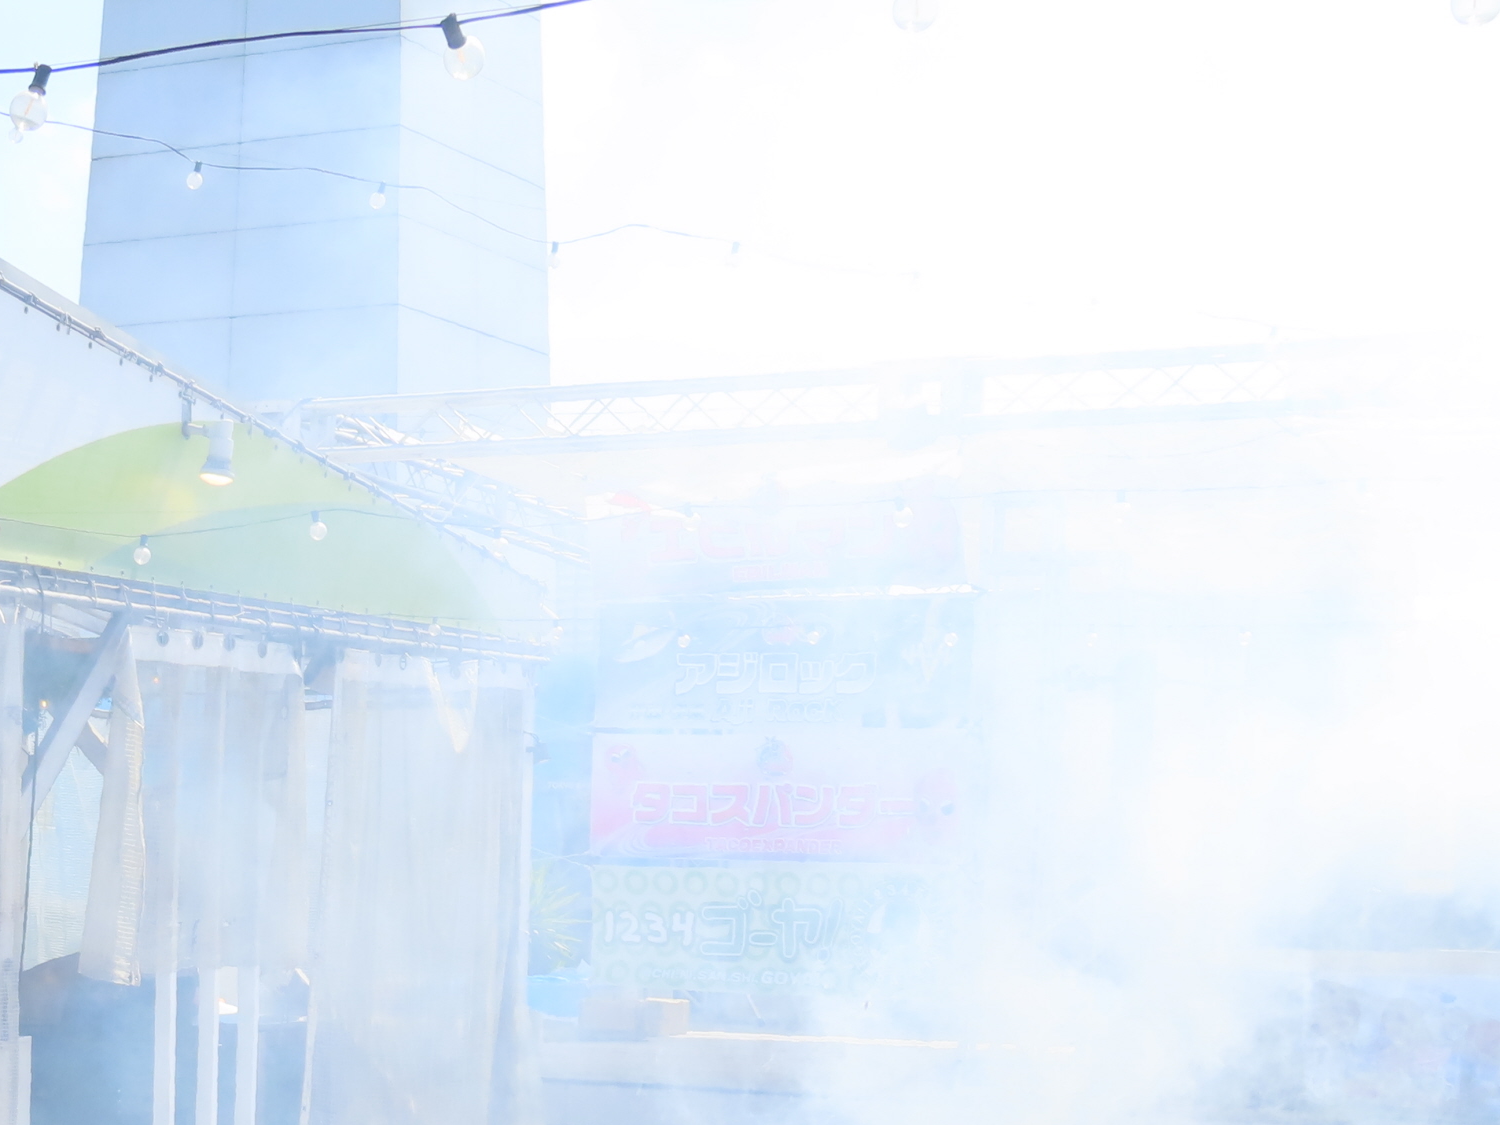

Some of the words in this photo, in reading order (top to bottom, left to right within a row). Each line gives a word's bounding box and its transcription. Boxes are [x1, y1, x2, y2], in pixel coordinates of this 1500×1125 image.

[674, 650, 877, 696] アジロック
[631, 780, 915, 829] タコスパンダー
